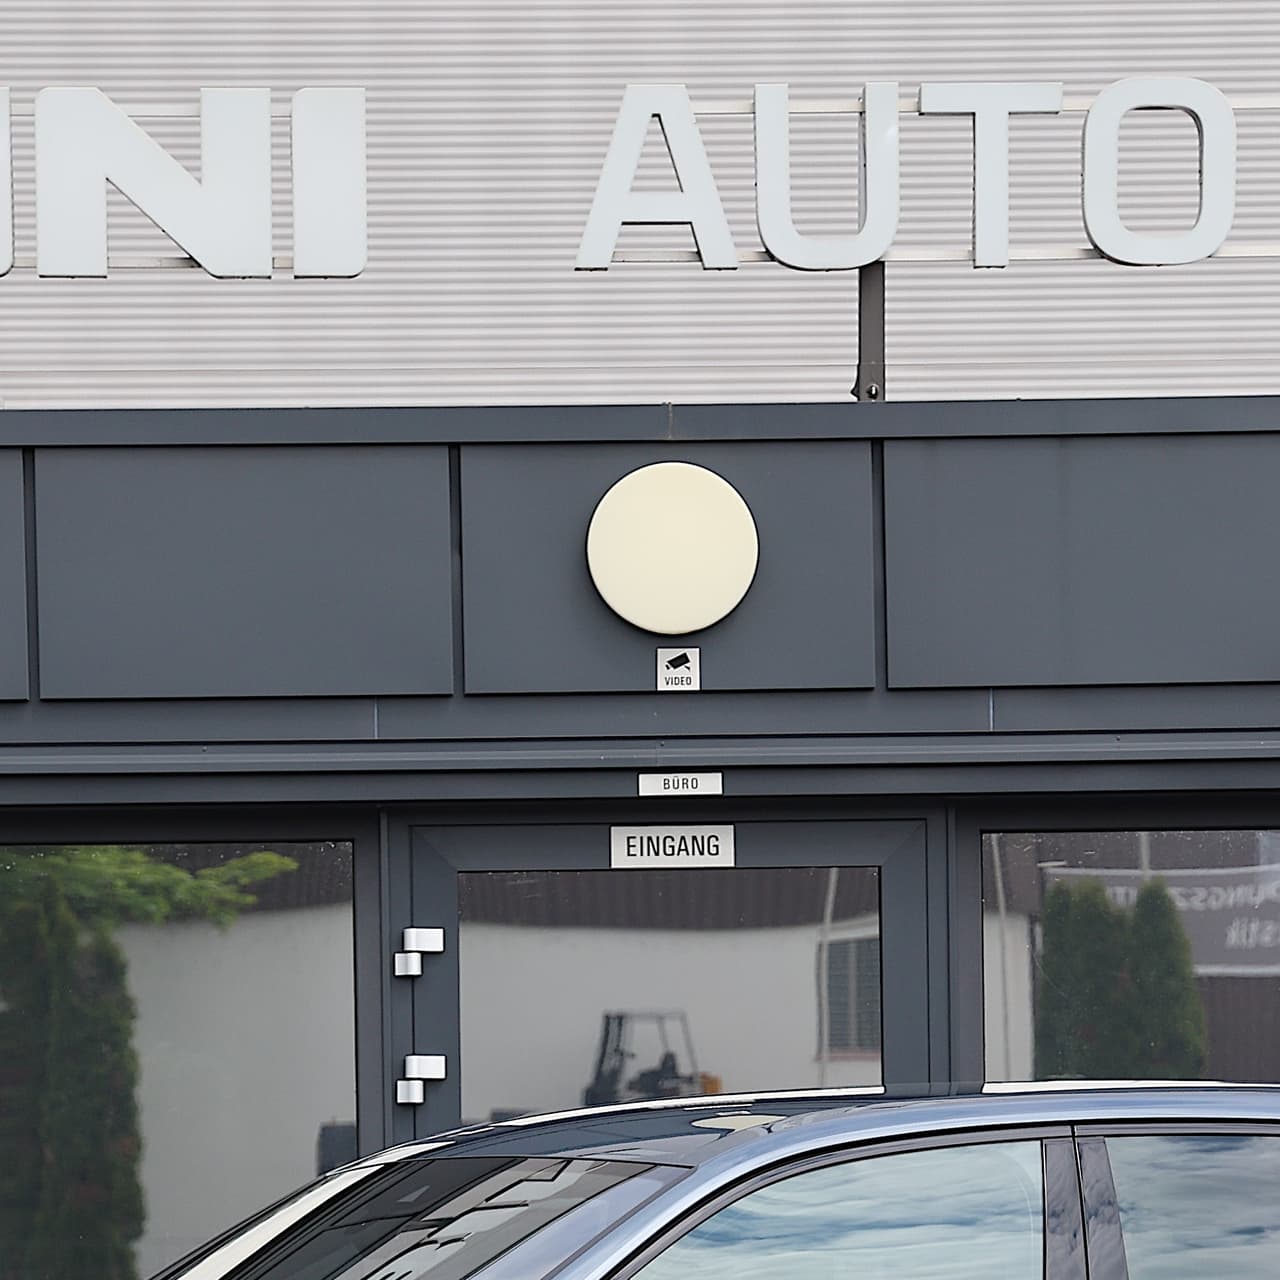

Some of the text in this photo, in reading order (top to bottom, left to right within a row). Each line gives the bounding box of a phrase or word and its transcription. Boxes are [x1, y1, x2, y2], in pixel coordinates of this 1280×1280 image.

[574, 76, 1237, 272] AUTO
[664, 676, 692, 686] VIDEO
[663, 775, 699, 790] BÜRO
[626, 834, 720, 857] EINGANG
